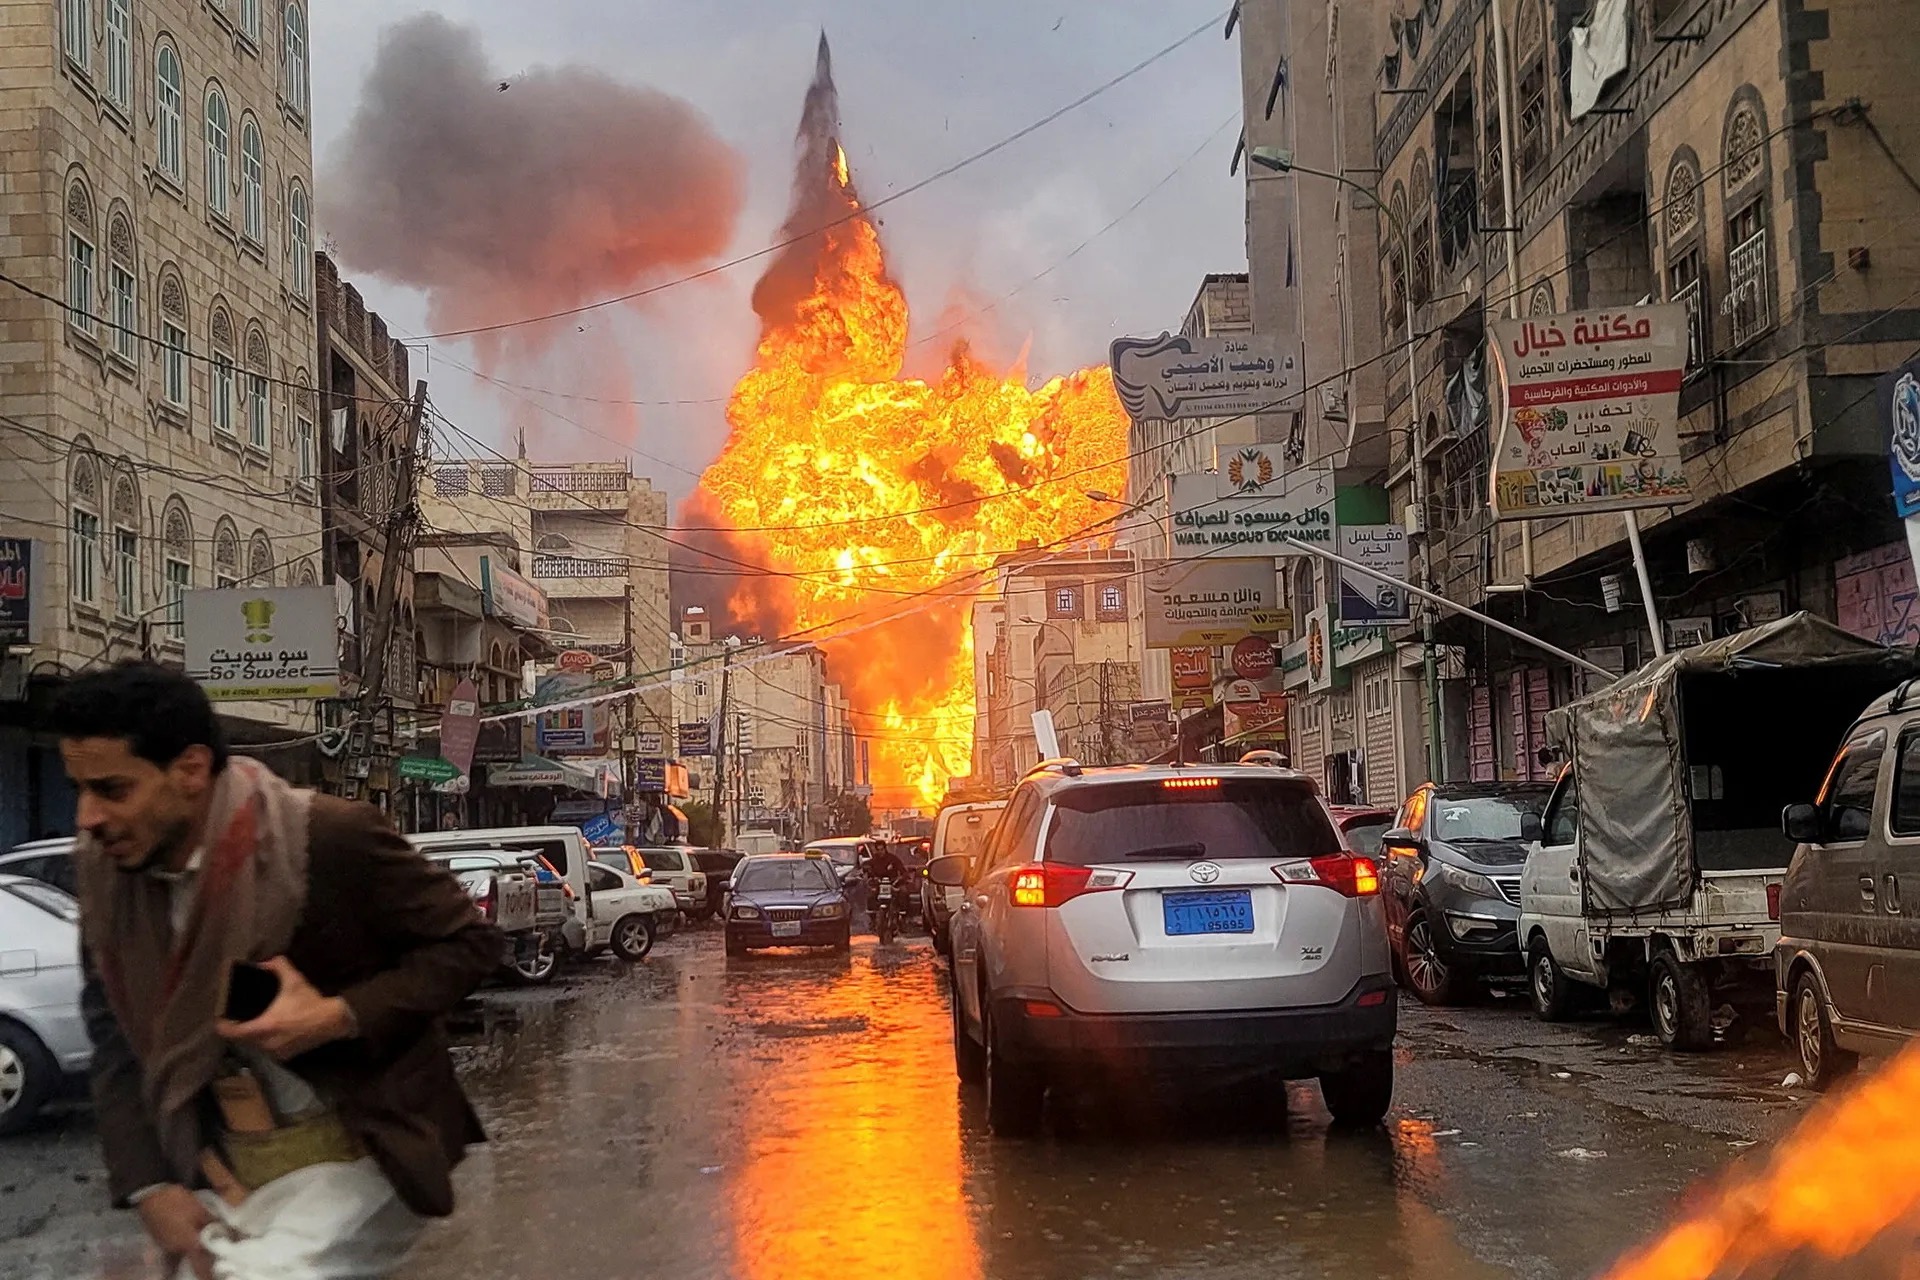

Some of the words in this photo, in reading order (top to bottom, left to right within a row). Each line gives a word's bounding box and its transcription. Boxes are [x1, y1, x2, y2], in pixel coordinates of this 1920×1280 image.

[1513, 320, 1566, 358] خيال
[1573, 313, 1651, 352] مكتبة
[1225, 341, 1248, 353] عيادة
[1161, 354, 1224, 382] الأصبحي
[1229, 357, 1275, 374] وهيب
[1557, 358, 1615, 375] ومستحضرات
[1617, 352, 1652, 370] للعطور
[1519, 362, 1554, 379] التجميل
[1524, 386, 1573, 400] والقرطاسية
[1598, 402, 1632, 417] تحف
[1574, 422, 1611, 438] هدايا
[1550, 441, 1585, 459] العاب
[1174, 510, 1229, 528] للصرافة
[1234, 511, 1291, 527] مسعود
[1296, 507, 1330, 525] وائل
[1174, 532, 1208, 545] WAEL
[1211, 531, 1263, 544] MASOUD
[1267, 529, 1331, 543] EXCHANGE
[1349, 528, 1403, 544] مغاسل
[1360, 543, 1390, 556] الخير
[1163, 591, 1230, 607] مسعود
[1233, 588, 1262, 604] وائل
[1165, 607, 1217, 620] والتحويلات
[210, 649, 273, 668] سويت
[279, 650, 308, 667] سو
[210, 666, 235, 680] So
[243, 665, 309, 680] Sweet
[1201, 919, 1245, 931] 195695
